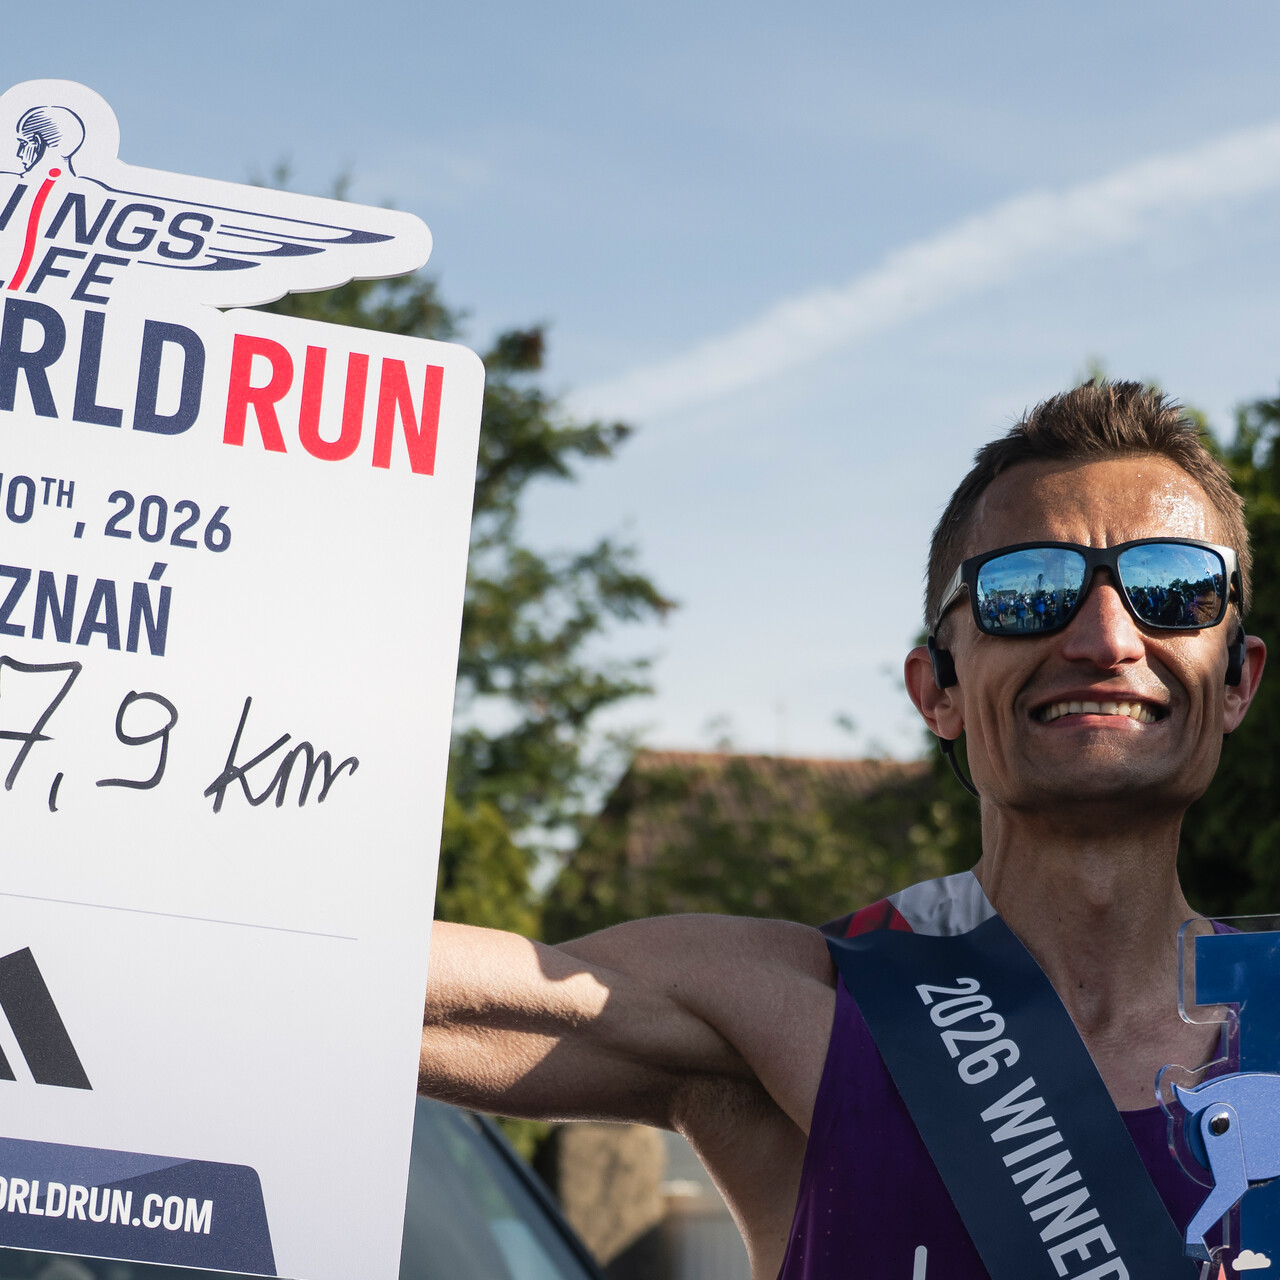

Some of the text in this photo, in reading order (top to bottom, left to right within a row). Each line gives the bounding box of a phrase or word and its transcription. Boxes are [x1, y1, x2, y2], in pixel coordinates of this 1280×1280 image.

[223, 334, 444, 477] RUN
[104, 490, 232, 553] 2026
[204, 696, 359, 813] km
[916, 977, 1020, 1085] 2026
